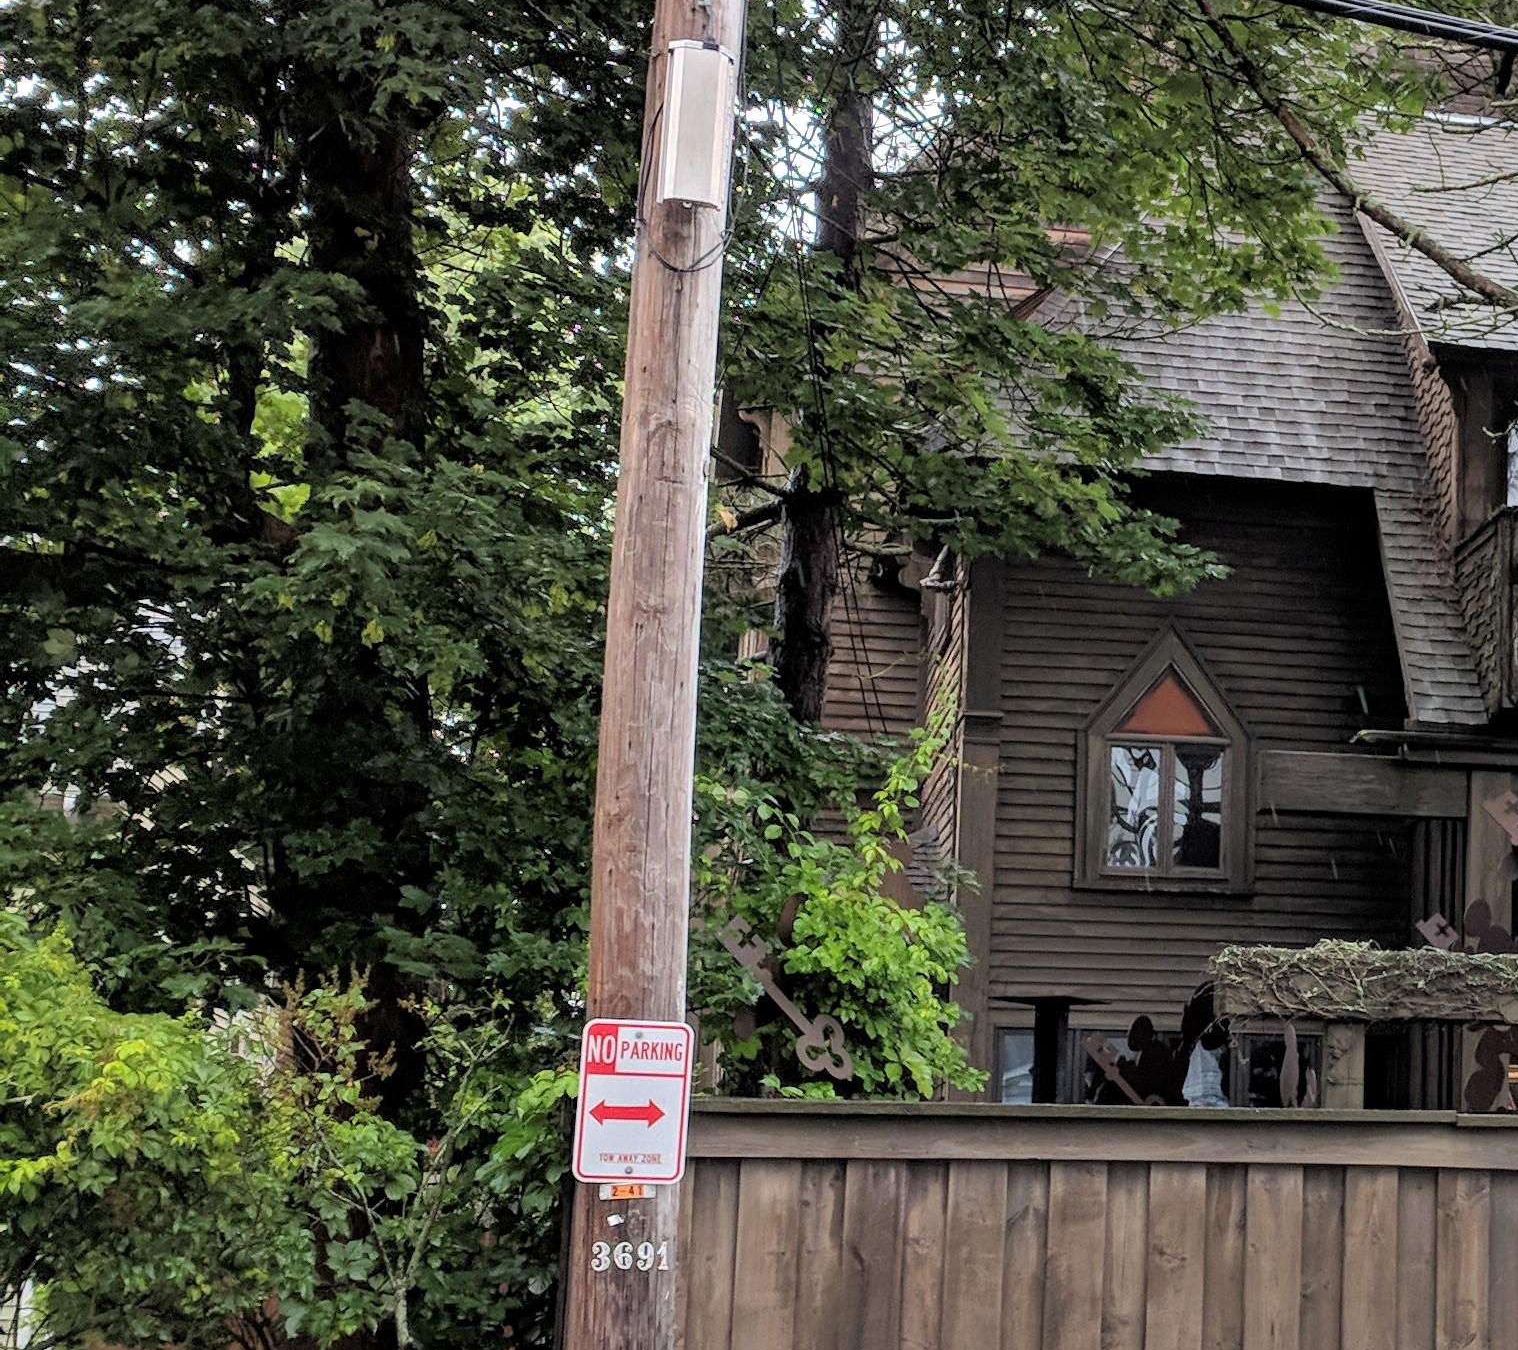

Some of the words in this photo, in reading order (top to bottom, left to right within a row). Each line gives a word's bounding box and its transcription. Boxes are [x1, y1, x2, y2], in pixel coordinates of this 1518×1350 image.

[587, 1034, 616, 1064] NO
[620, 1041, 684, 1062] PARKING
[599, 1153, 614, 1162] TOW
[618, 1153, 638, 1164] AWAY
[641, 1154, 661, 1164] ZONE
[612, 1185, 643, 1197] 2-41
[591, 1241, 669, 1271] 3691
